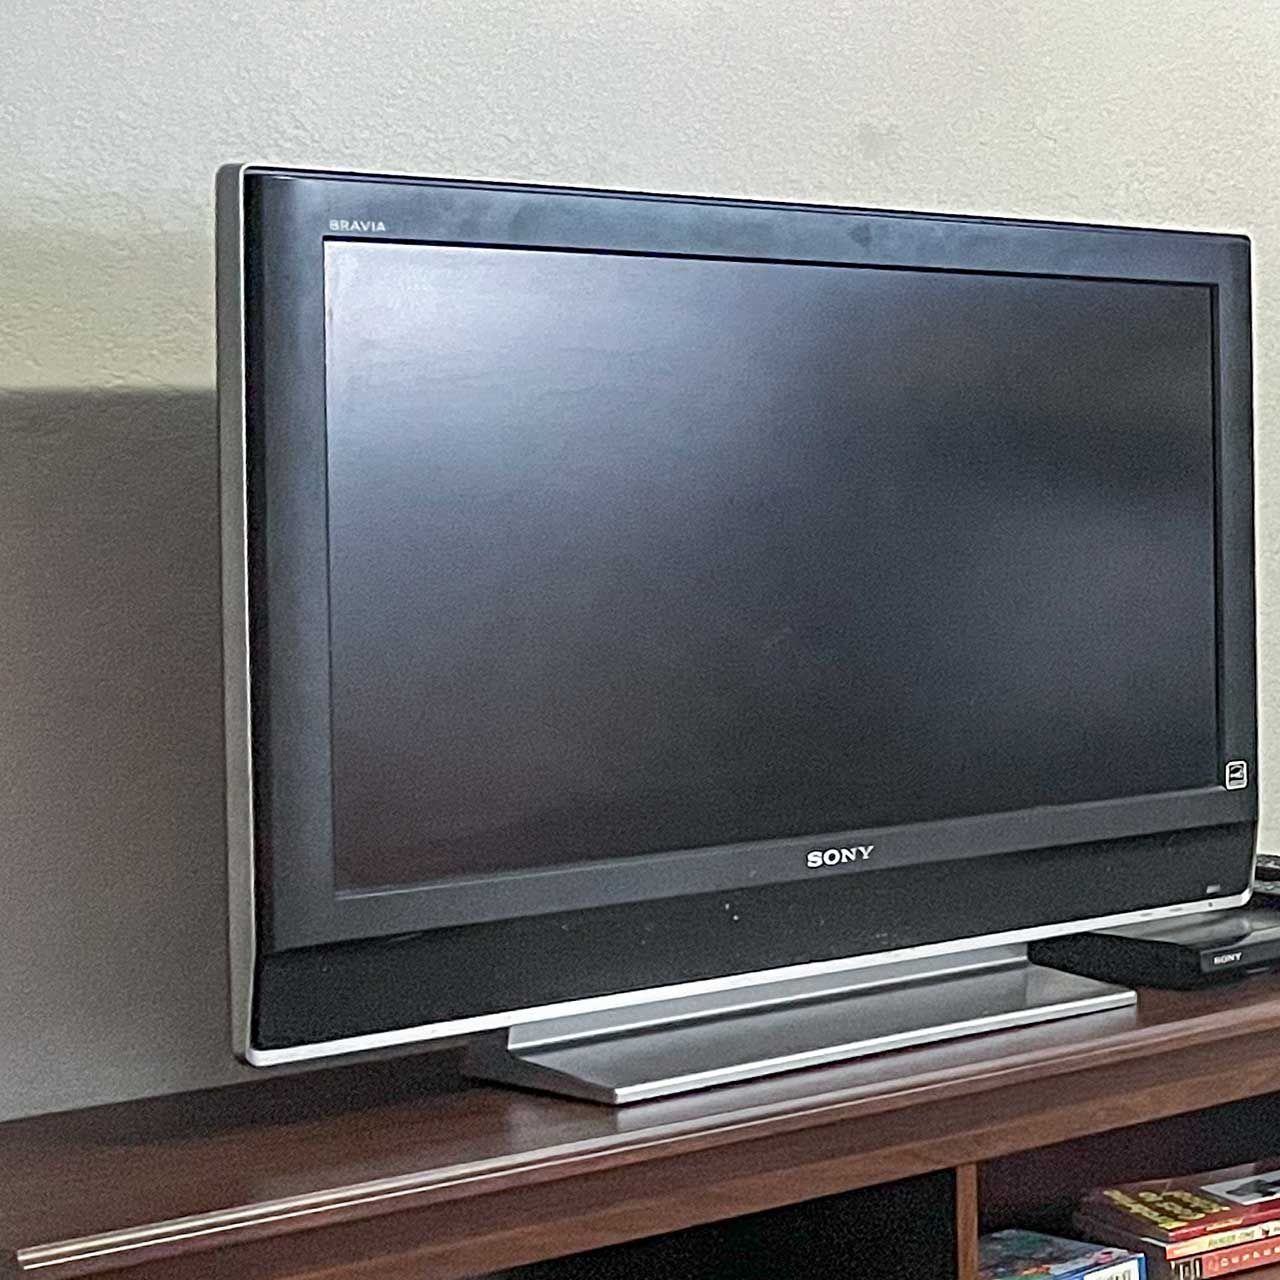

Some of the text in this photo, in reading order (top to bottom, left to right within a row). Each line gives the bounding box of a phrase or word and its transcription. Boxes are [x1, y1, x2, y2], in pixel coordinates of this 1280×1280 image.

[329, 219, 386, 232] BRAVIA
[807, 845, 875, 868] SONY
[1213, 951, 1242, 965] SONY
